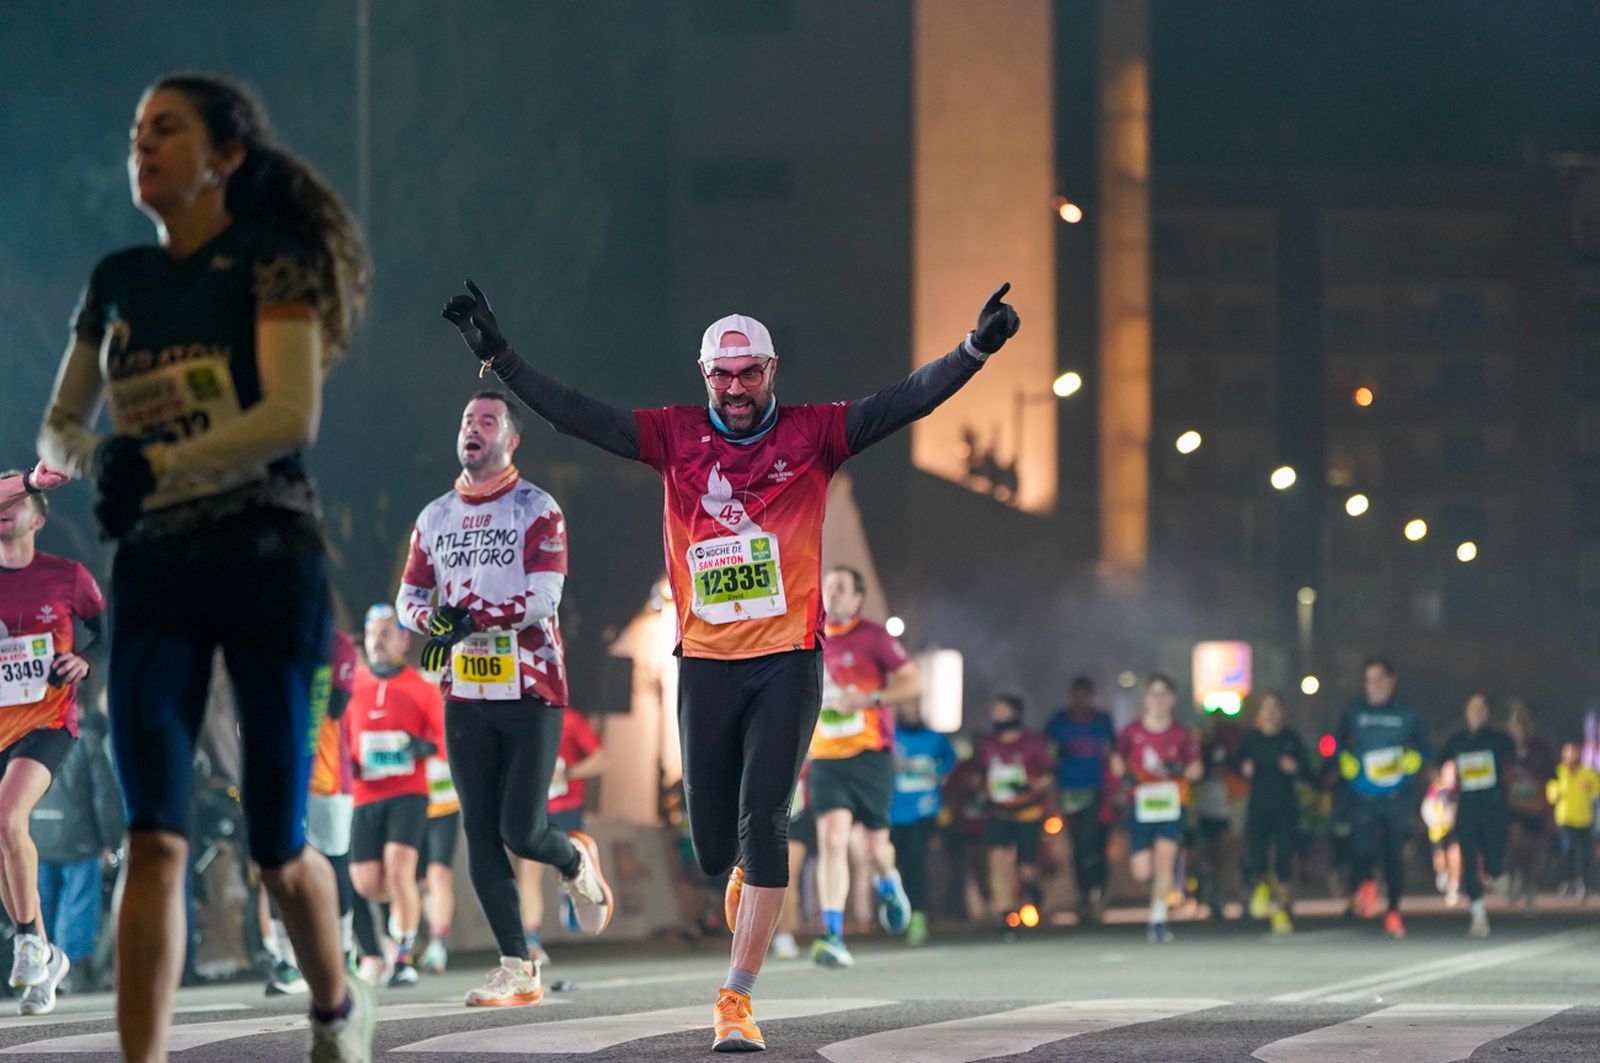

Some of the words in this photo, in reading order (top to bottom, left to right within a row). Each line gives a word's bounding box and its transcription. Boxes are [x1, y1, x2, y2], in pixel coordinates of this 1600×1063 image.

[462, 514, 492, 530] CLUB
[719, 504, 743, 525] 43
[436, 529, 518, 551] ATLETISMO
[441, 549, 515, 569] MONTORO
[706, 545, 730, 558] NOCHE
[732, 544, 743, 554] DE
[699, 560, 713, 571] SAN
[701, 563, 770, 596] 12335
[2, 659, 44, 682] 3349
[461, 655, 502, 677] 7106
